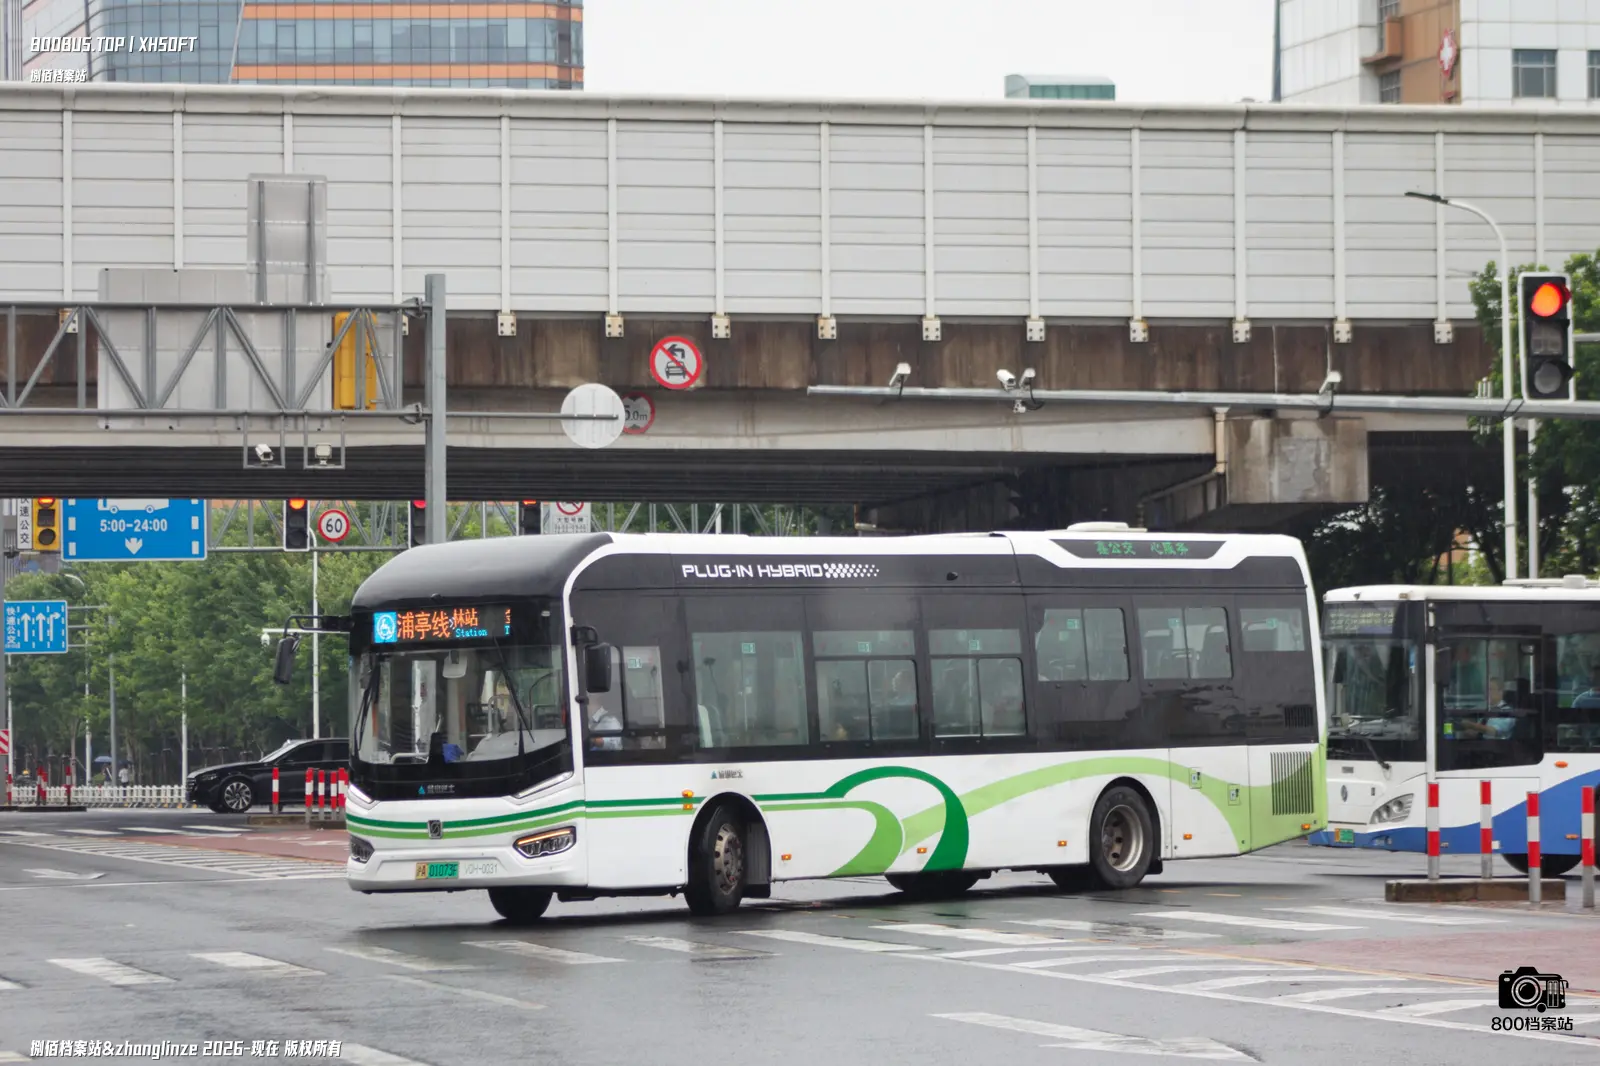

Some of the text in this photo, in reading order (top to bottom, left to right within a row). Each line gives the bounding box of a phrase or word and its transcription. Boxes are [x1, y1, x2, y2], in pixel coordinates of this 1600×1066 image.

[100, 518, 168, 533] 5:00-24:00
[325, 518, 343, 533] 60
[681, 563, 824, 578] PLUG-IN HYBRID
[396, 610, 451, 640] 浦亭线
[455, 627, 488, 638] Station
